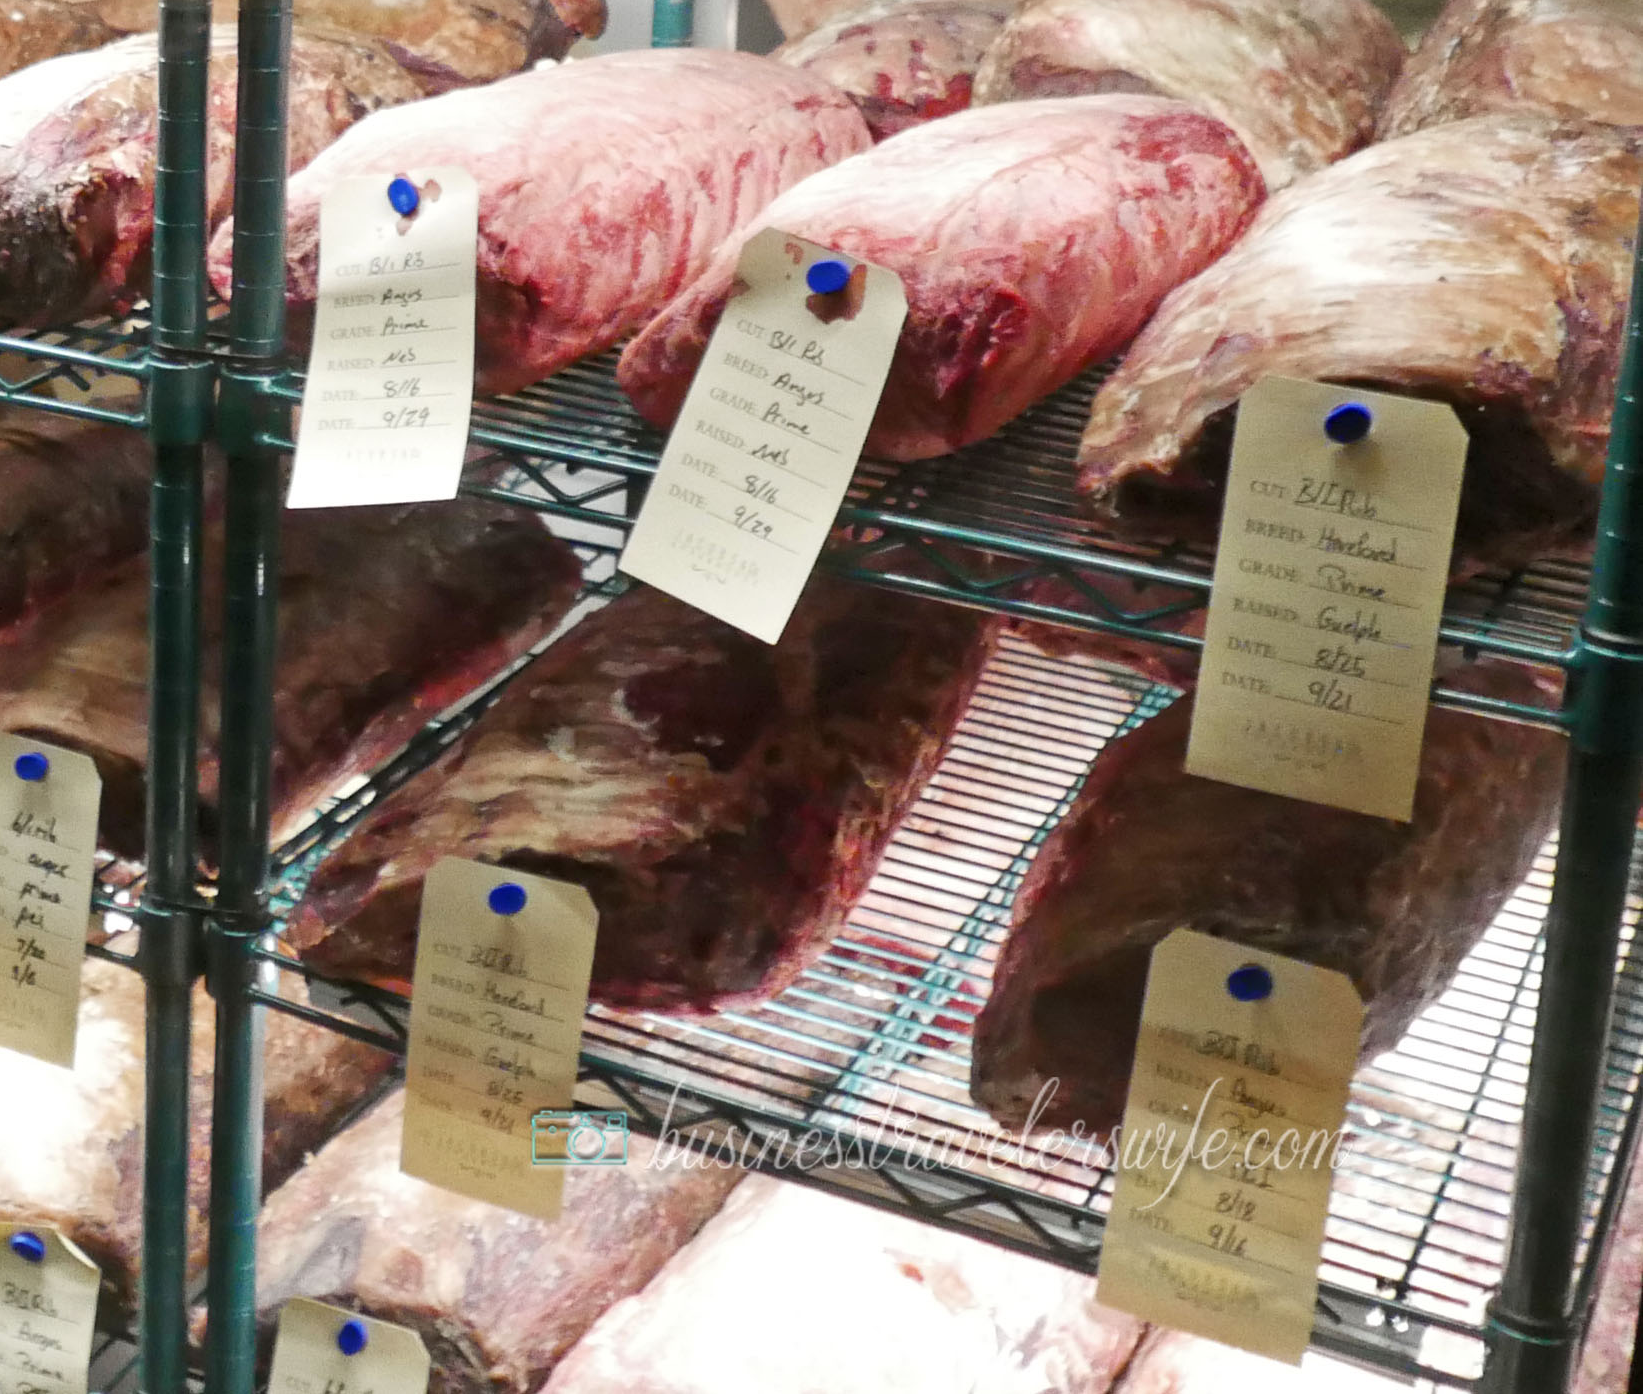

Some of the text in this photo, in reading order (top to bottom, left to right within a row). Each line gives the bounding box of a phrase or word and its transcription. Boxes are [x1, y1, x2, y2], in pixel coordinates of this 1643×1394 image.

[761, 403, 811, 437] Prime
[744, 473, 777, 505] 8/16
[732, 505, 774, 539] 9/29
[1308, 679, 1353, 710] 9/21
